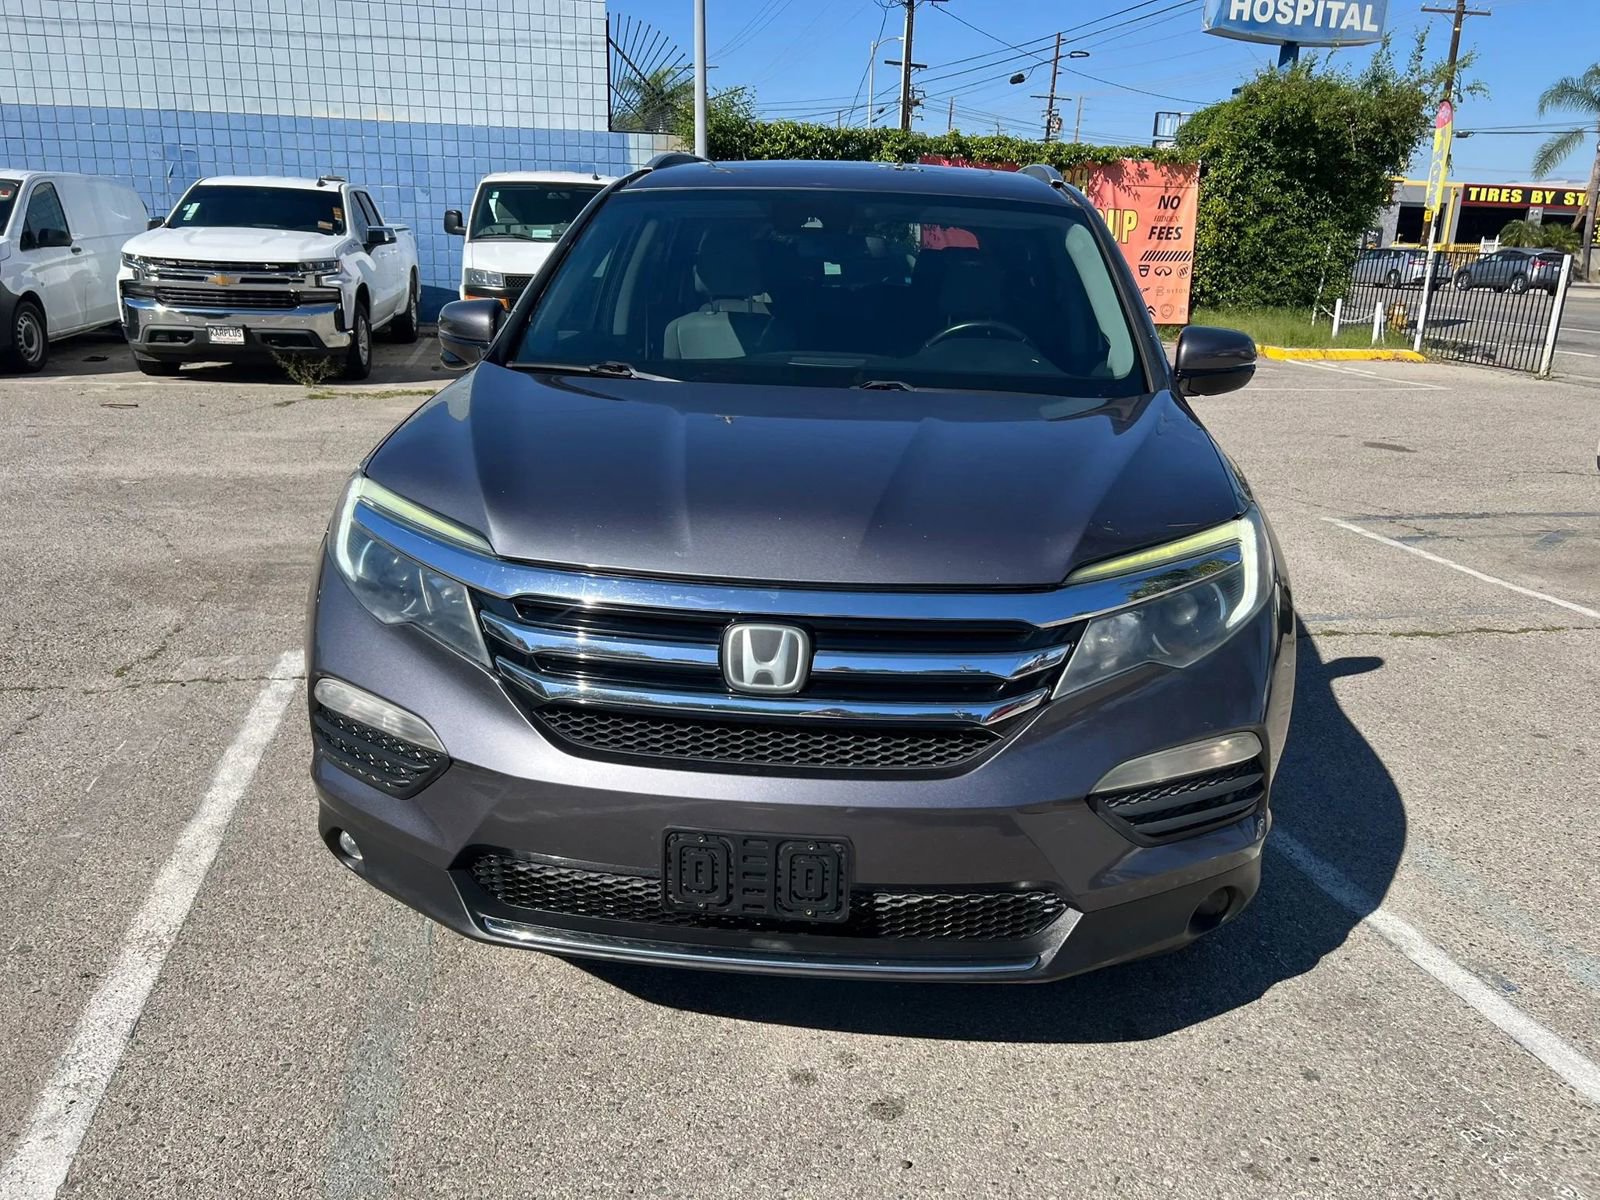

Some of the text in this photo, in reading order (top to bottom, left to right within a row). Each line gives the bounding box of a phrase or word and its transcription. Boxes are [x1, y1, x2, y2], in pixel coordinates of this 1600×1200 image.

[1229, 0, 1379, 32] HOSPITAL
[1157, 195, 1181, 210] NO
[1468, 187, 1590, 206] TIRES BY ST
[1097, 208, 1138, 244] UP
[1147, 226, 1183, 240] FEES
[209, 327, 242, 337] KARPLUS
